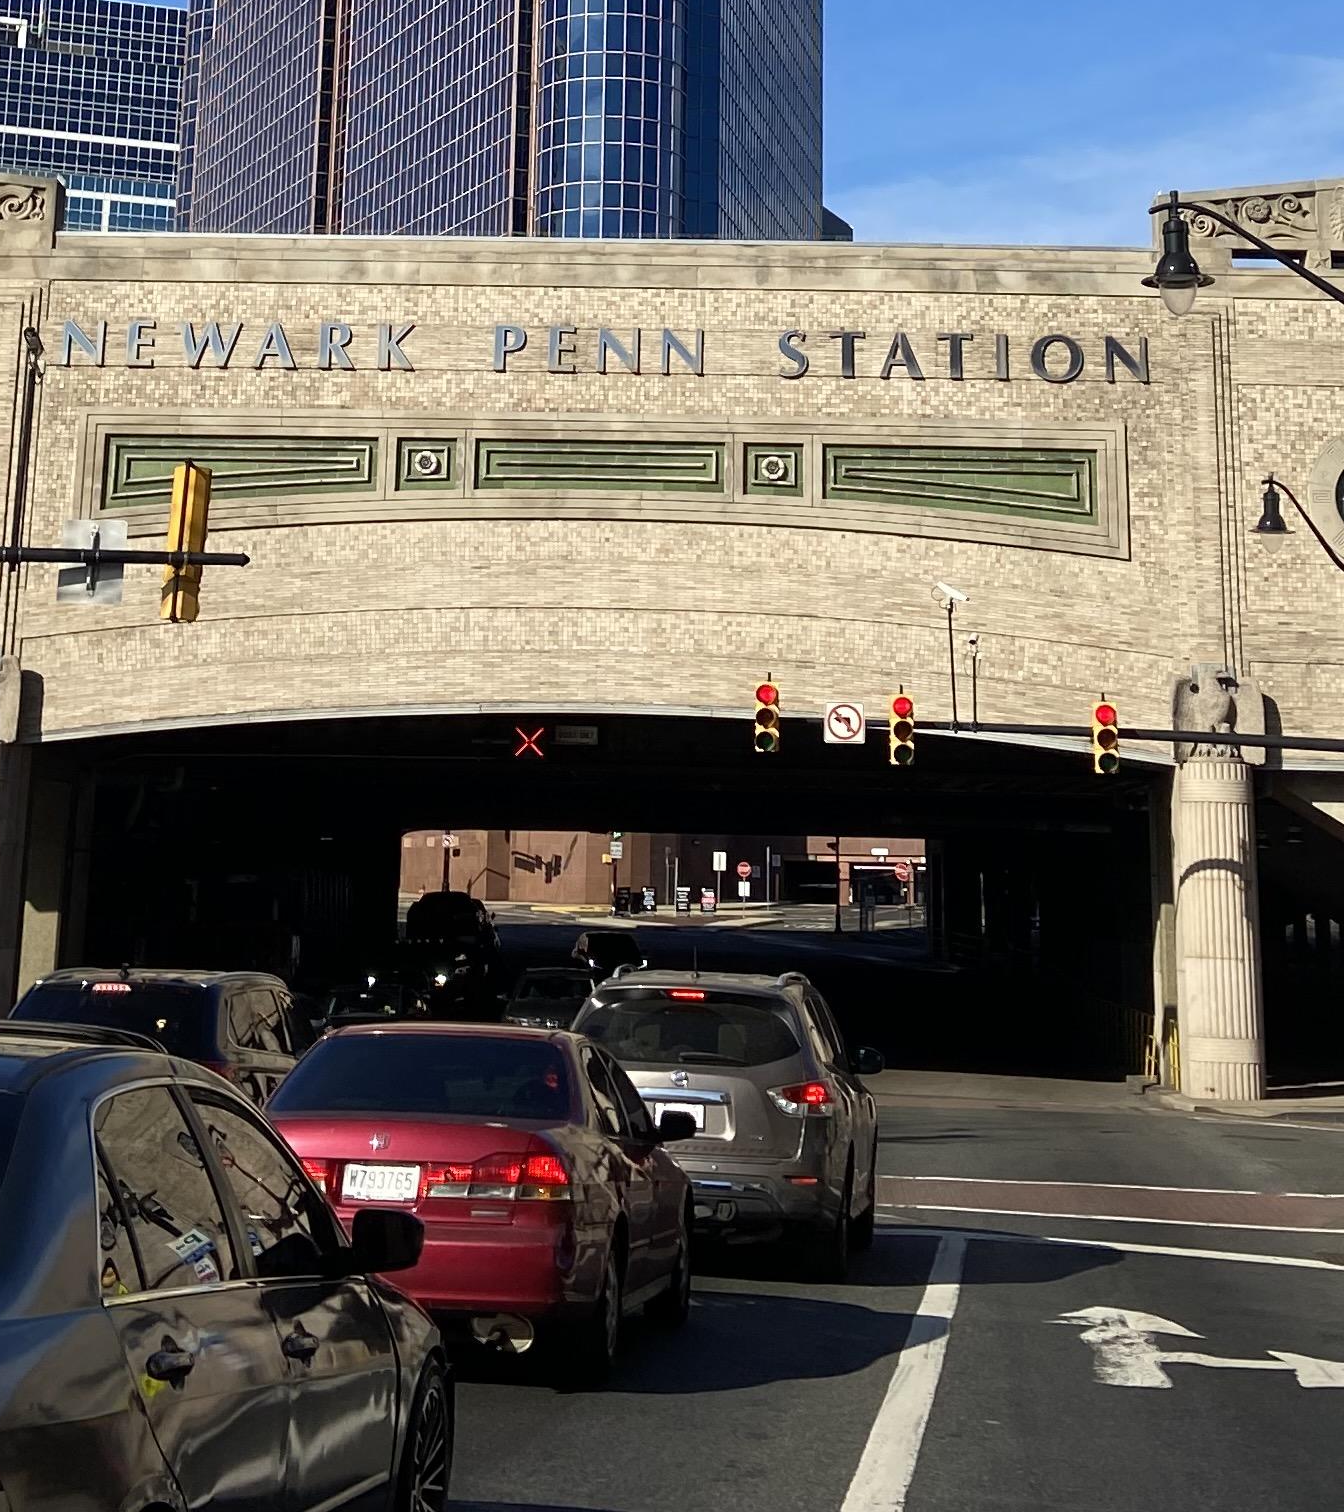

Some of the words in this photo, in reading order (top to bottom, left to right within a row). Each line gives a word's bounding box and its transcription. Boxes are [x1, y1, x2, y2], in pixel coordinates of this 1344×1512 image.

[62, 319, 416, 372] NEWARK
[492, 324, 704, 377] PENN
[778, 329, 1150, 385] STATION
